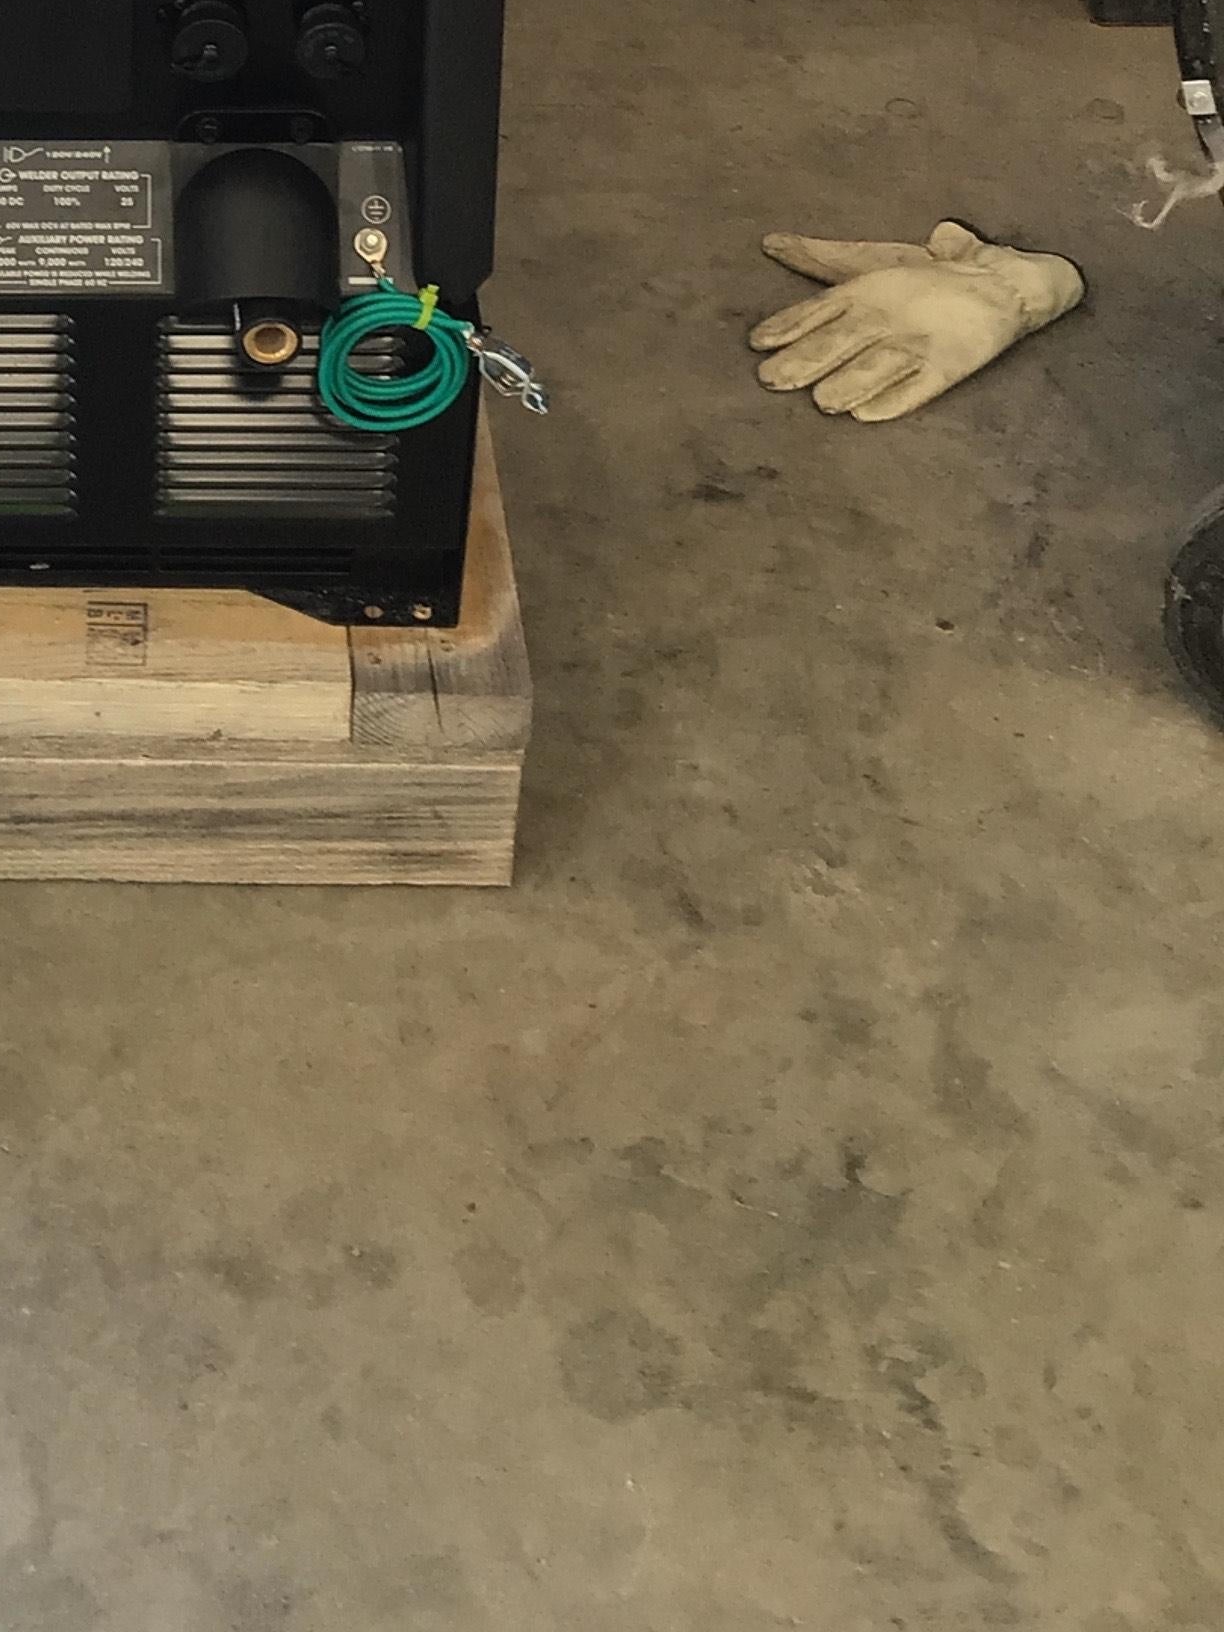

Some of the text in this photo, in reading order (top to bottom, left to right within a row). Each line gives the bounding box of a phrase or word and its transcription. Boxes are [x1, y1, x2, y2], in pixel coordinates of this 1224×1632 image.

[18, 171, 139, 180] WELDER OUTPUT RATING
[8, 197, 24, 206] DC
[18, 235, 144, 244] AUXILIARY POWER RATING
